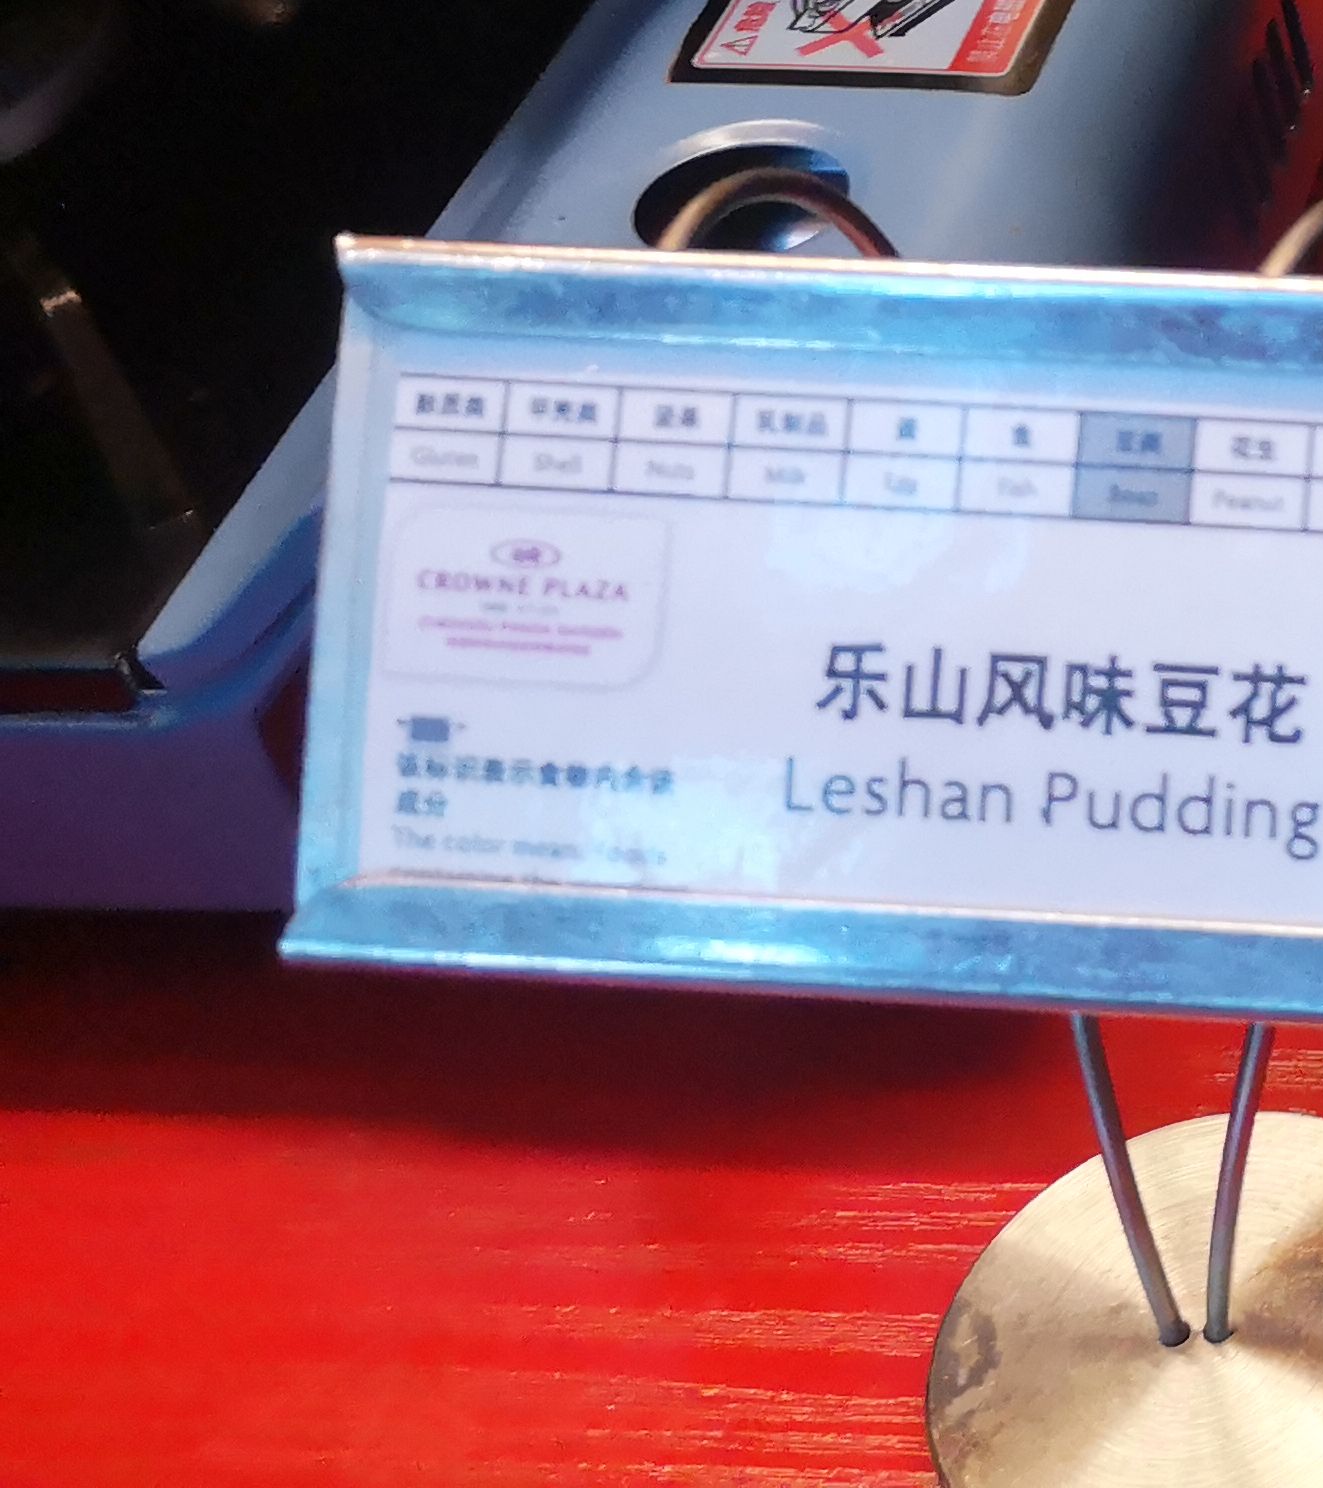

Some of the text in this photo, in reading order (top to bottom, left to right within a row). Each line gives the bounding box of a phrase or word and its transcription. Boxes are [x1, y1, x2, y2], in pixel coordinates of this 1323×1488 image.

[1231, 436, 1273, 461] 花生
[1212, 487, 1285, 512] Peanut
[417, 569, 629, 602] CROWNE PLAZA
[816, 642, 1307, 745] 乐山风味豆花
[785, 756, 1321, 861] Leshan Pudding
